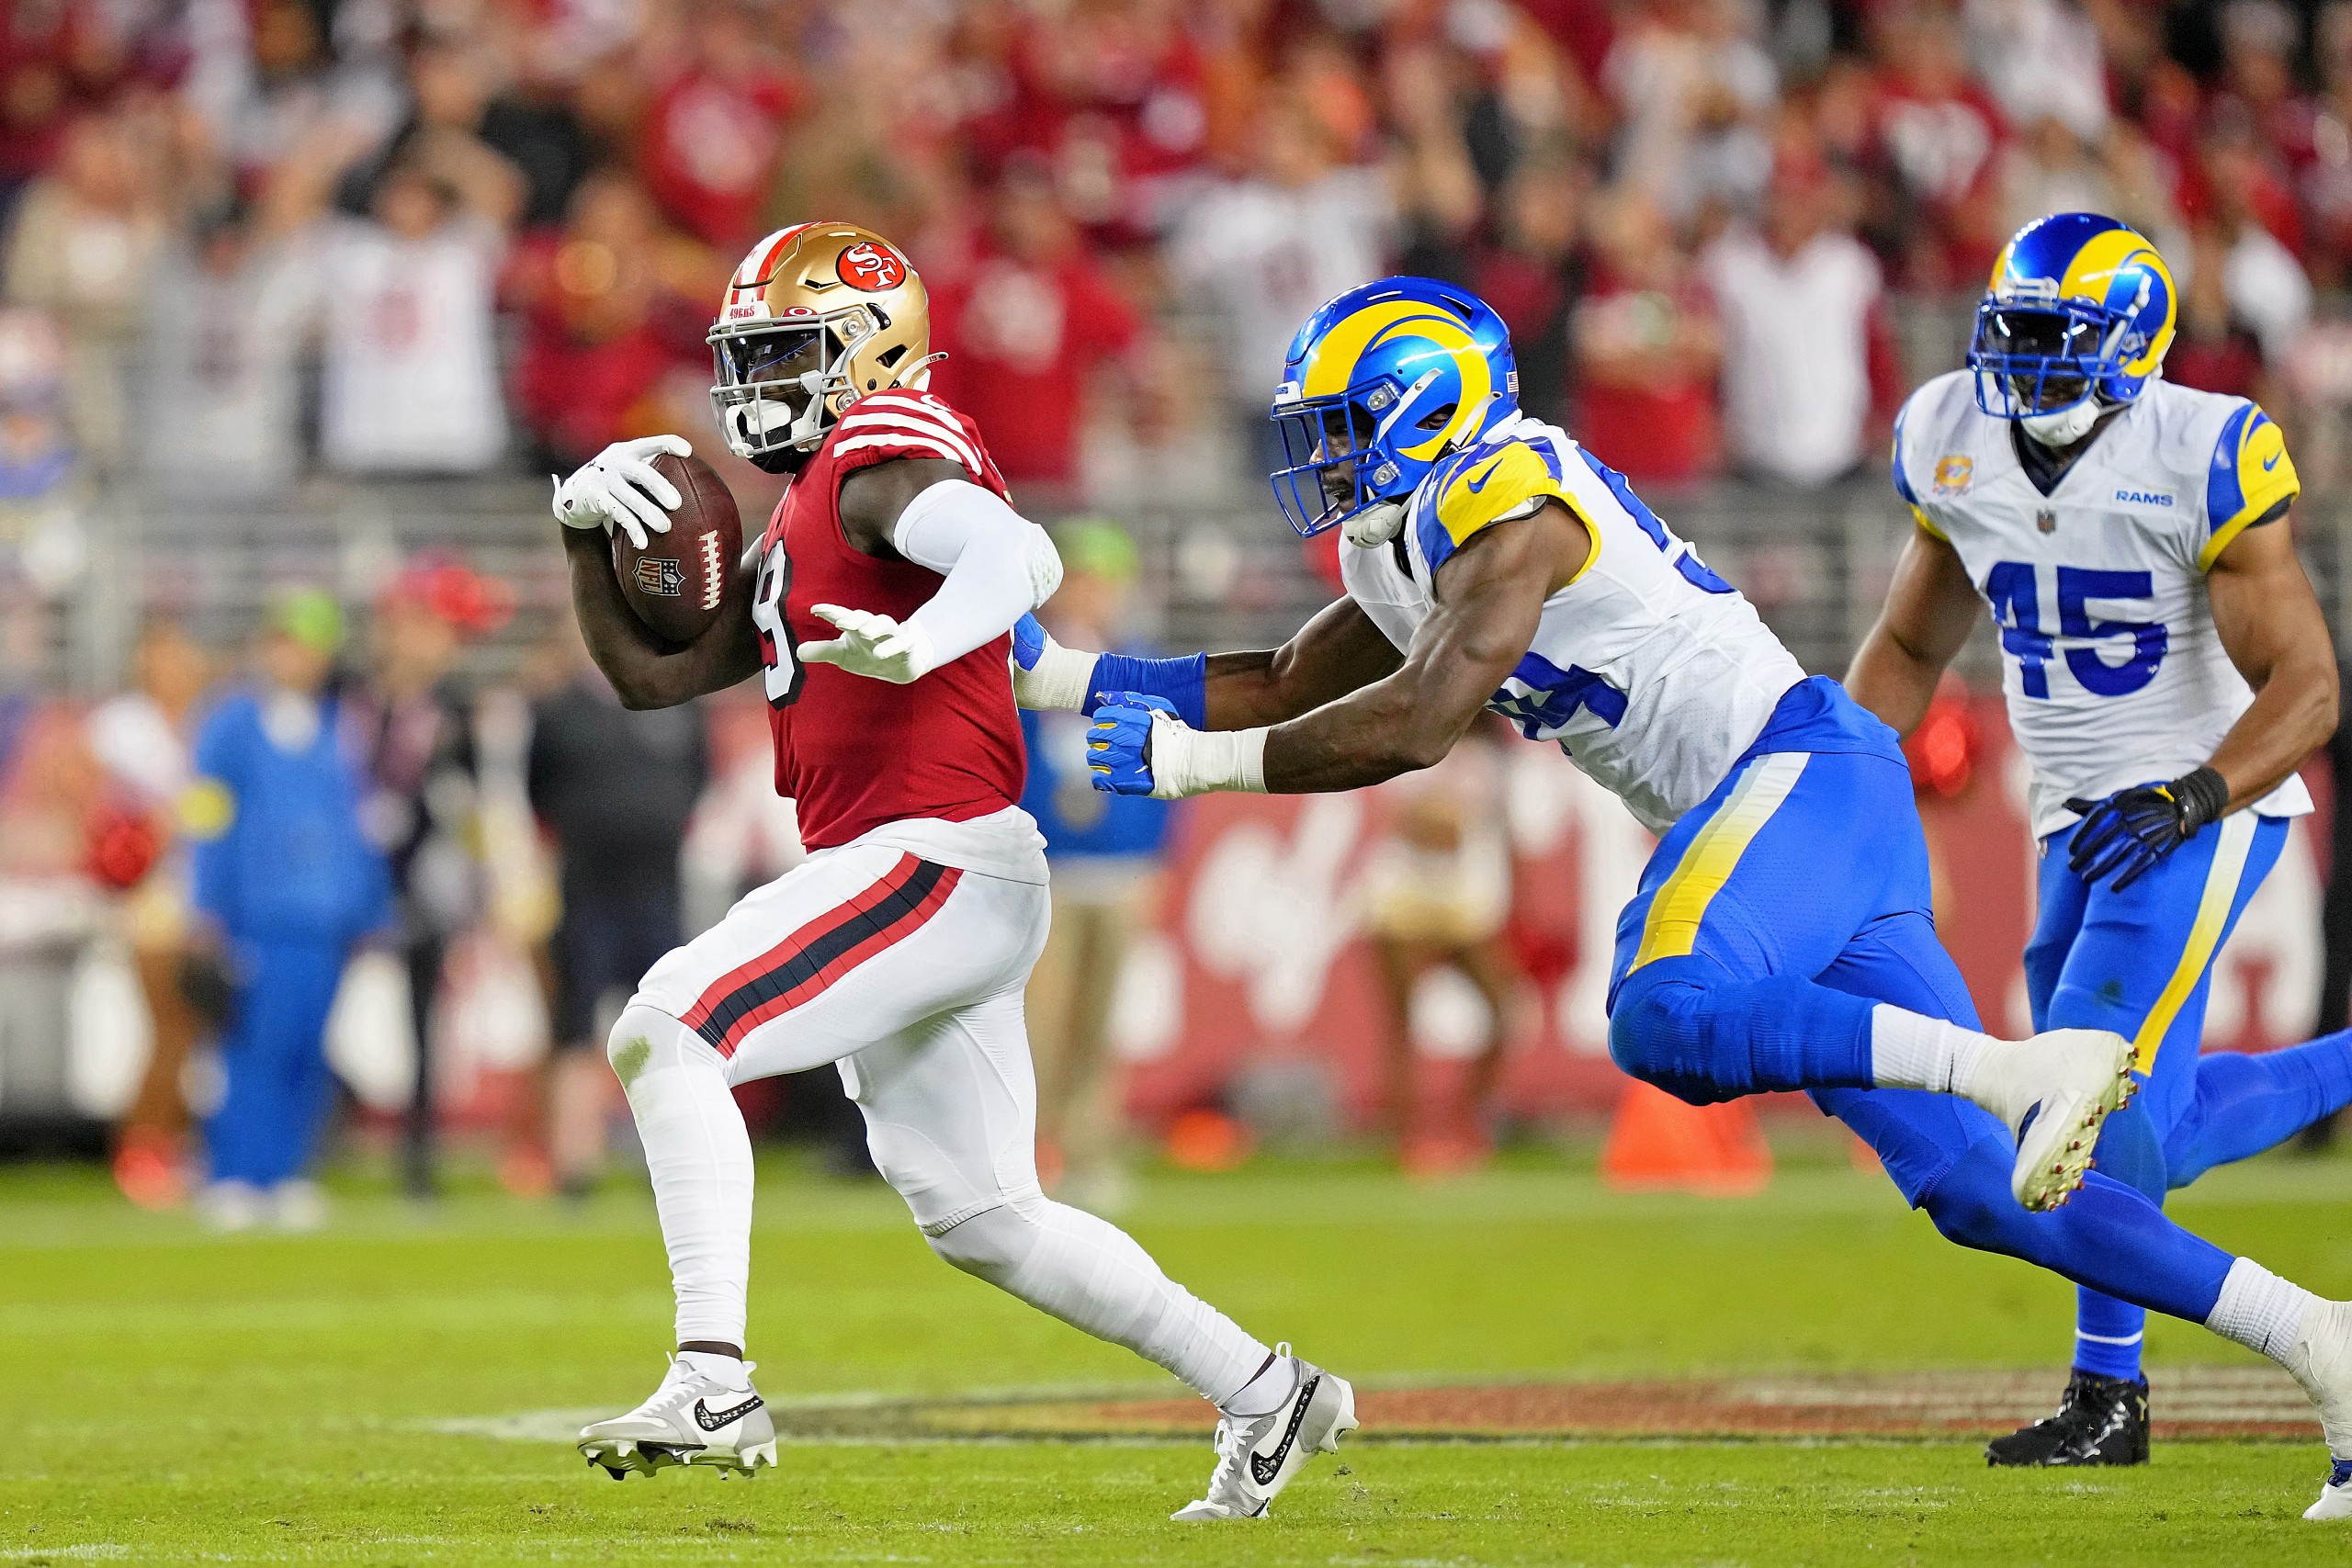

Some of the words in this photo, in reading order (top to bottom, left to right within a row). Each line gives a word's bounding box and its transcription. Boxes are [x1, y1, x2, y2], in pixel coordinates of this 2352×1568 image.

[846, 242, 898, 288] SF
[729, 305, 755, 320] 49ERS
[2116, 490, 2174, 507] RAMS
[639, 560, 661, 590] NFL
[1987, 561, 2168, 700] 45
